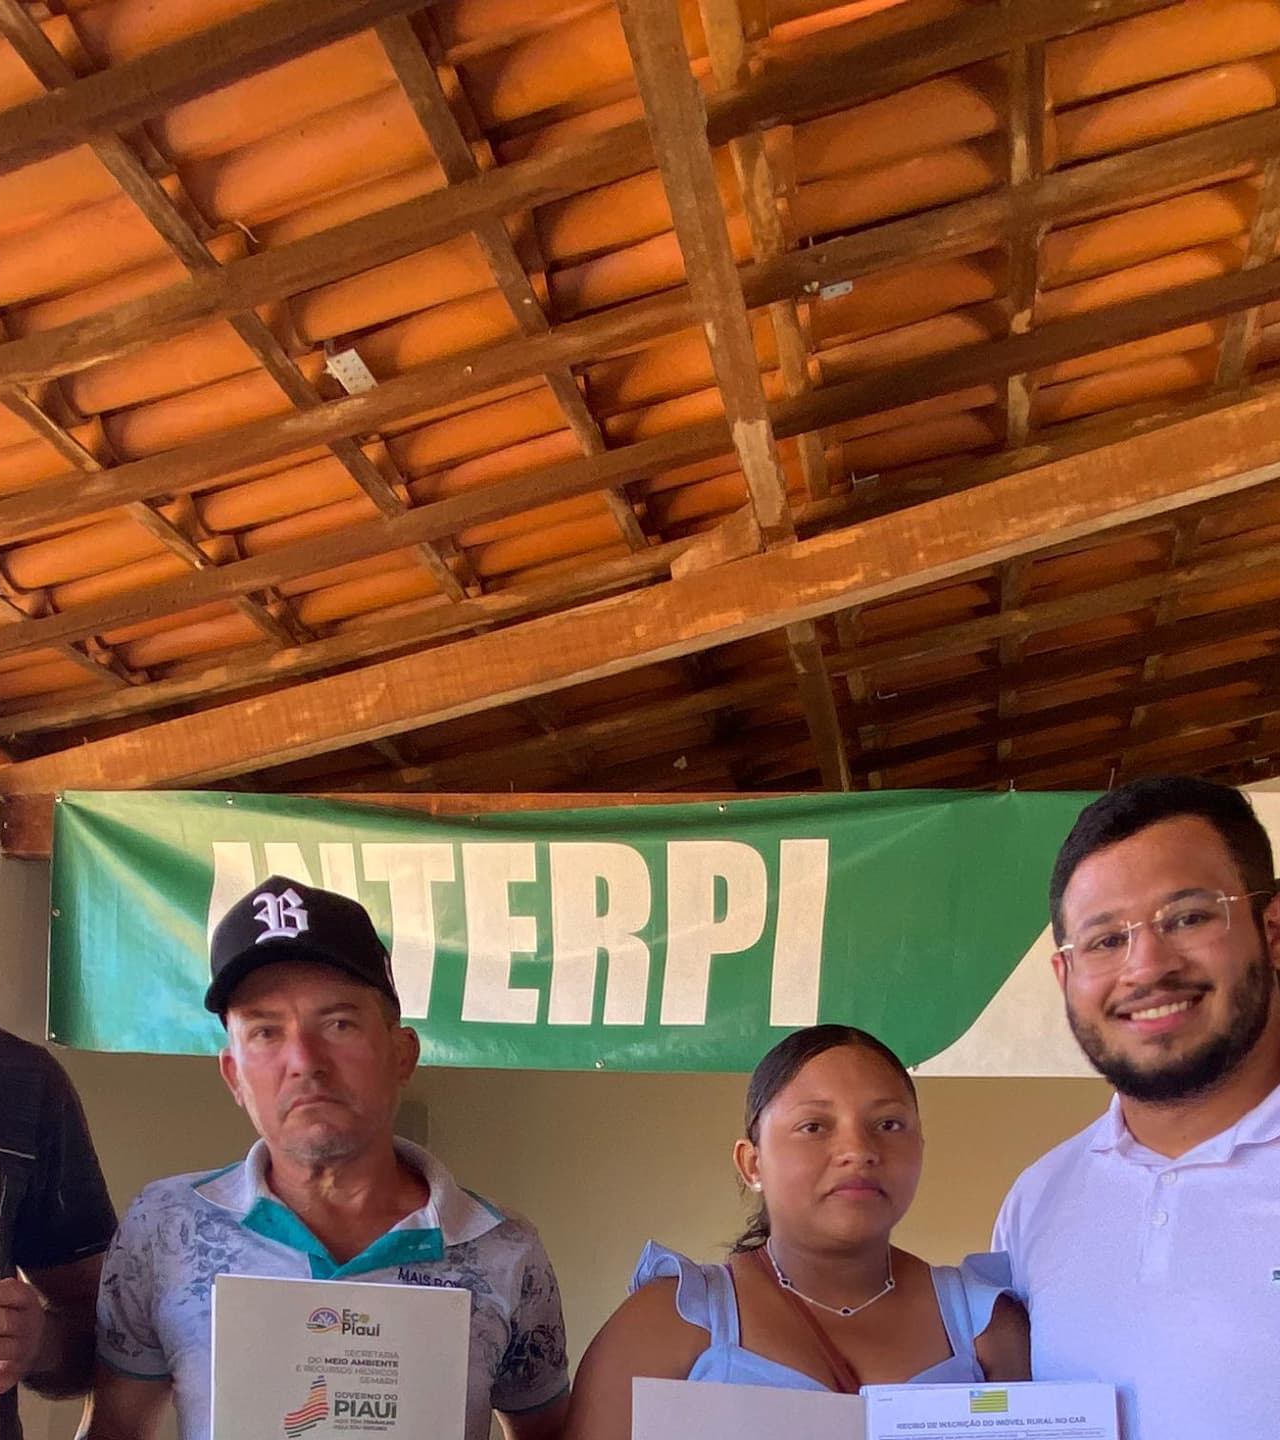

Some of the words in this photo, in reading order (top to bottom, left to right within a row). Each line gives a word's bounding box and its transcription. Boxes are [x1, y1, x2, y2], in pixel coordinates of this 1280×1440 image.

[252, 887, 310, 944] B
[207, 838, 829, 1028] TERPI
[397, 1266, 432, 1287] MAIS
[342, 1308, 370, 1323] Eco
[324, 1357, 349, 1365] MEIO
[350, 1359, 399, 1368] AMBIENTE
[334, 1391, 382, 1400] GOVERNO
[383, 1393, 398, 1401] DO
[1068, 1416, 1087, 1424] CAR
